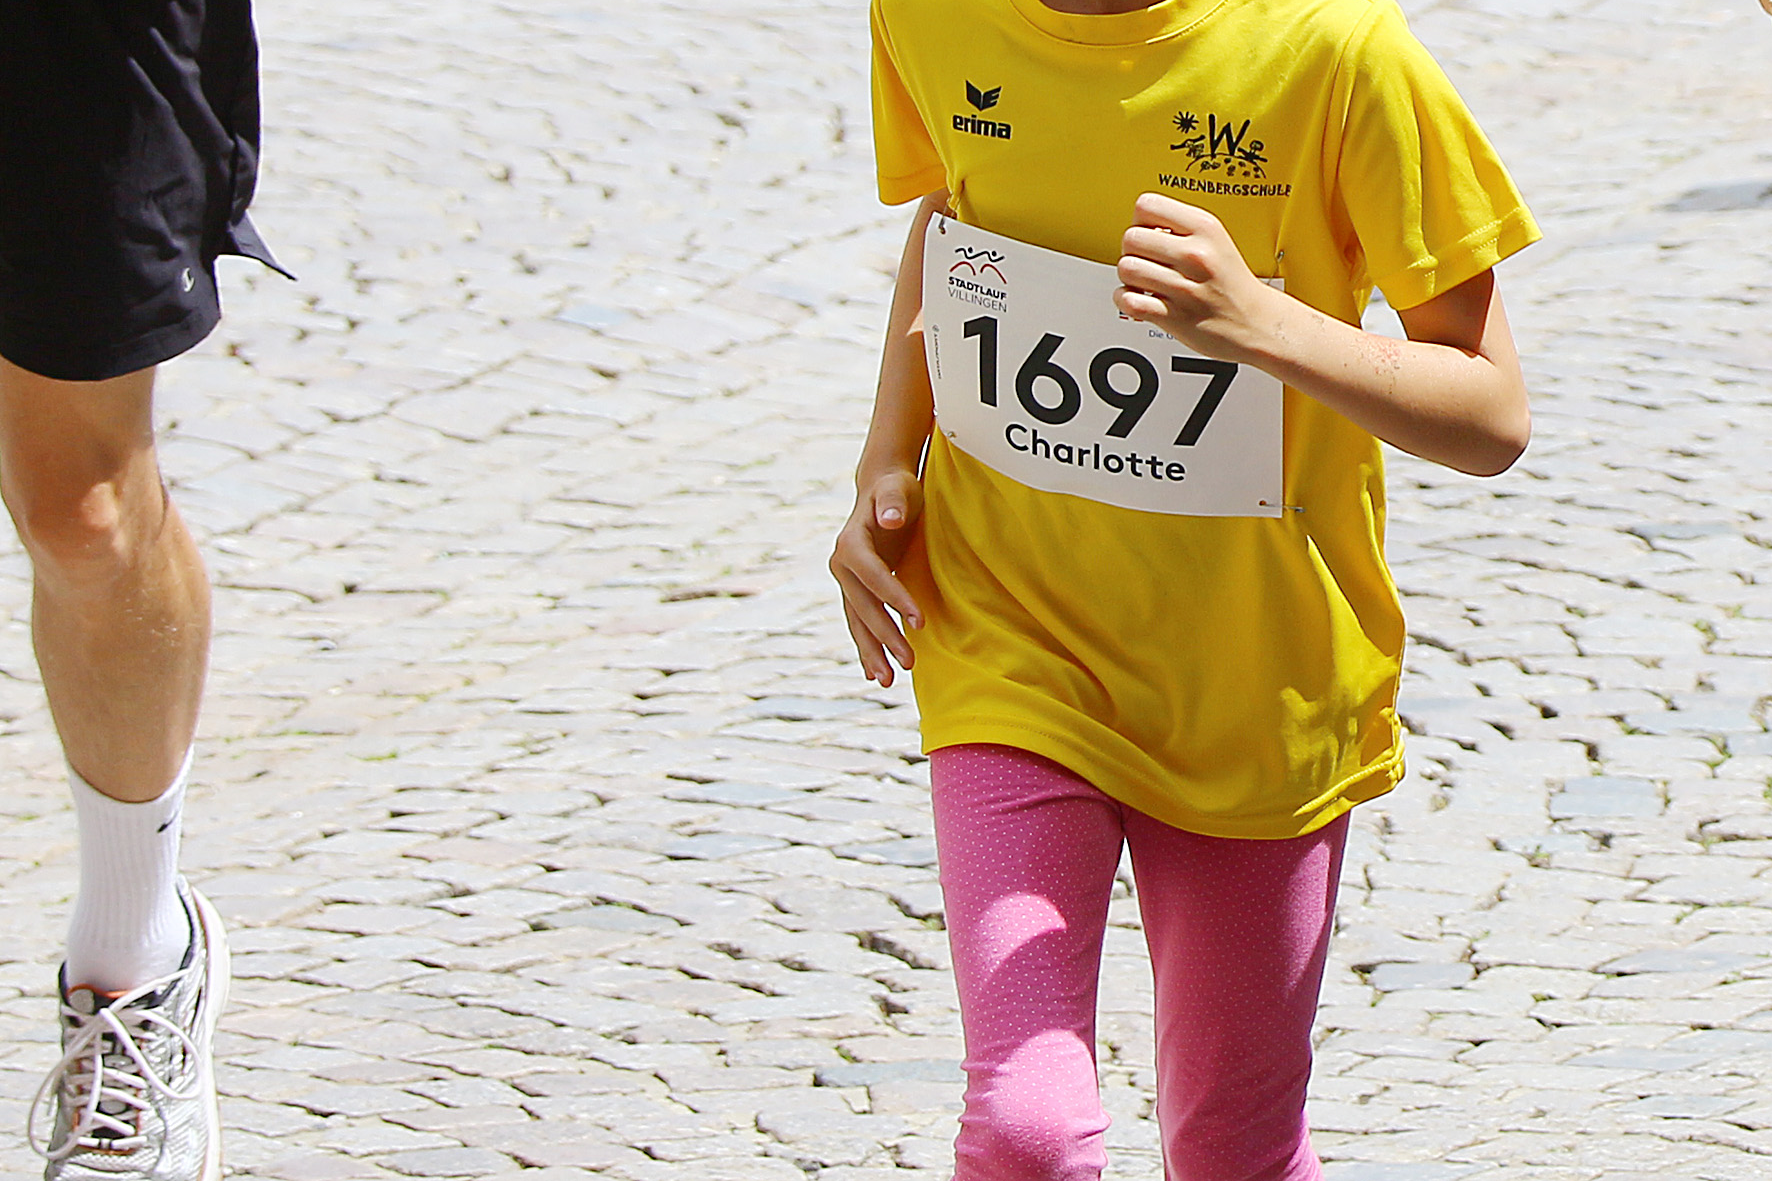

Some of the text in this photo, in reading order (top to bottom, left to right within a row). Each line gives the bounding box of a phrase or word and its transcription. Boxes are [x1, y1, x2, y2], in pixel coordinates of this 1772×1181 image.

[952, 114, 1012, 140] erima
[1158, 173, 1292, 197] WARENBERGSCHULE
[947, 286, 1007, 313] VILLINGEN
[948, 276, 1007, 301] STADTLAUF
[963, 315, 1239, 447] 1697
[1005, 422, 1186, 482] Charlotte
